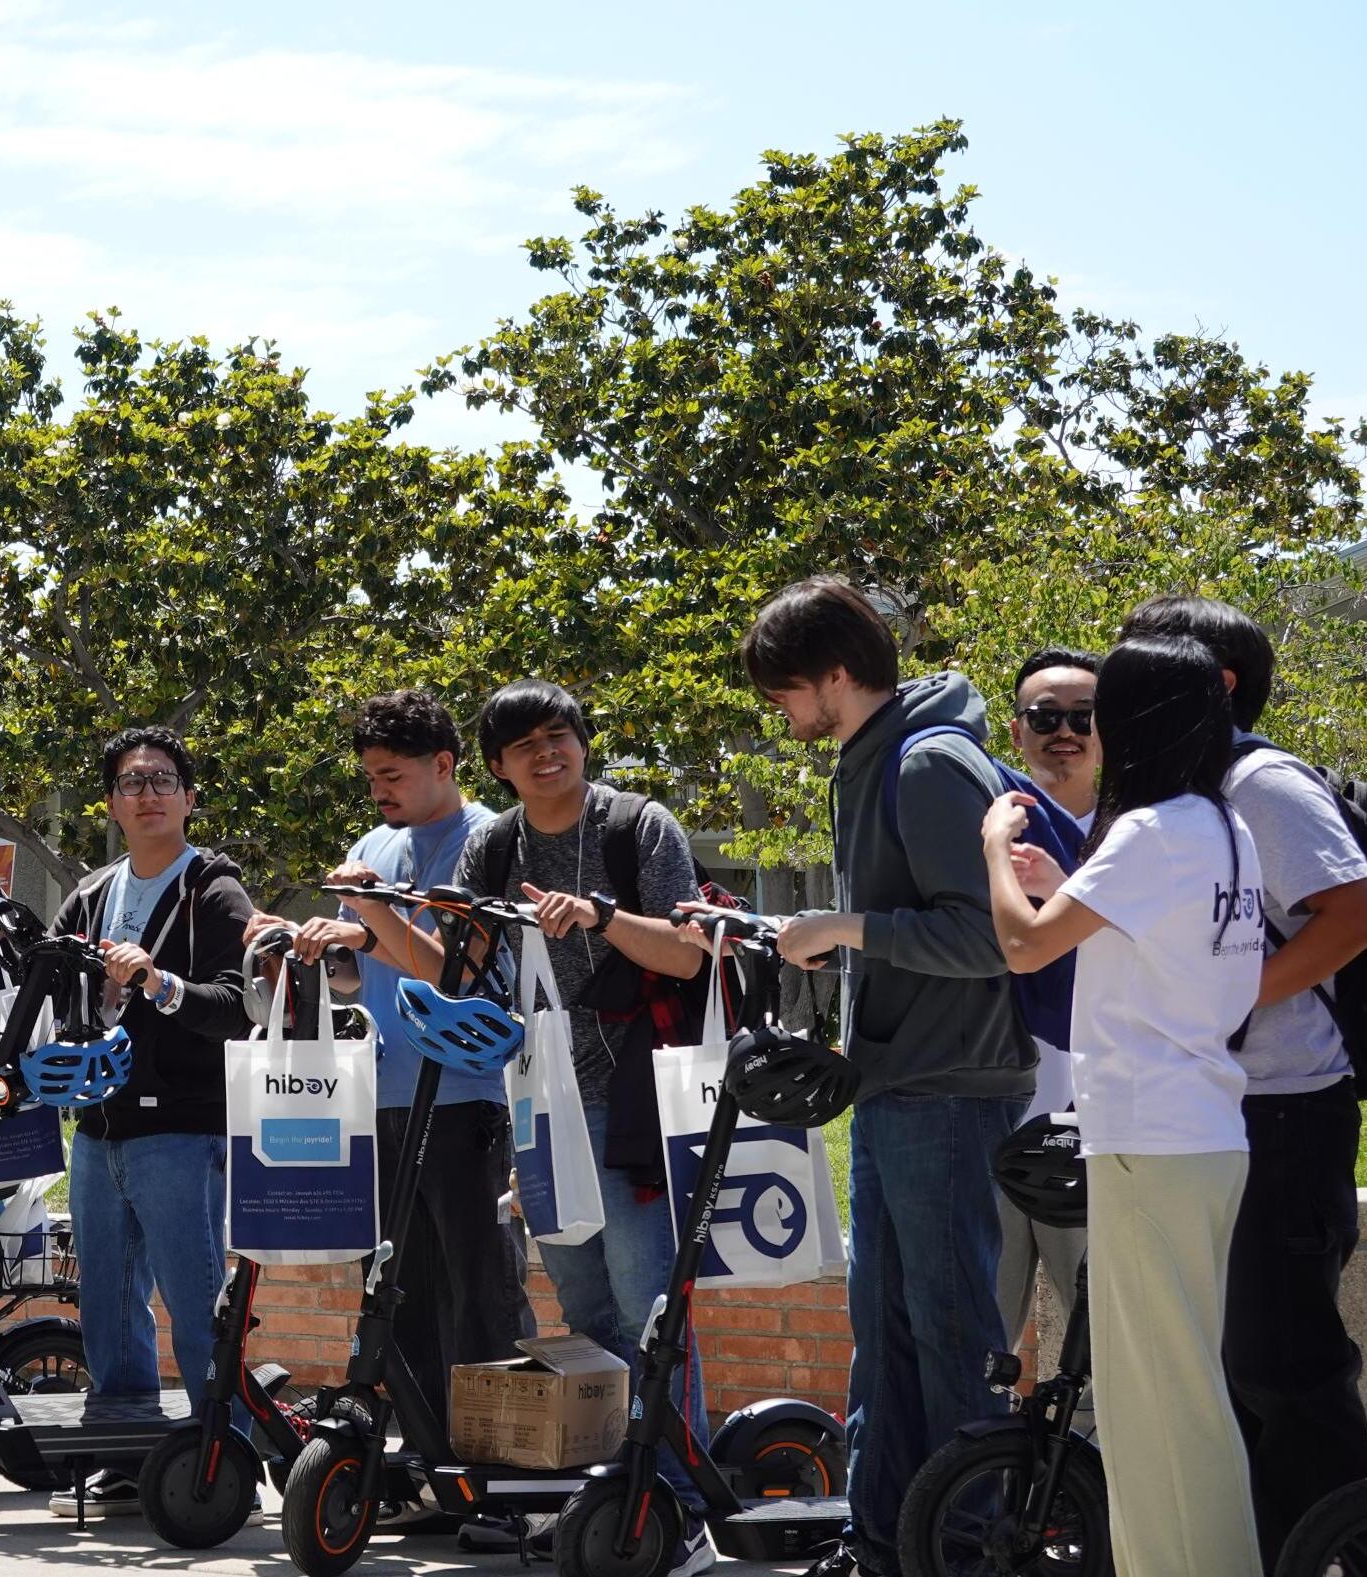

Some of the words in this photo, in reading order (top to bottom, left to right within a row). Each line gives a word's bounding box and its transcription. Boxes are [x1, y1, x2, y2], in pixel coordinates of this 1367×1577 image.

[265, 1074, 339, 1099] hiboy
[304, 1136, 333, 1145] joyride!
[1041, 1138, 1074, 1149] hiboy
[693, 1200, 715, 1244] hiboy
[578, 1382, 606, 1400] hiboy
